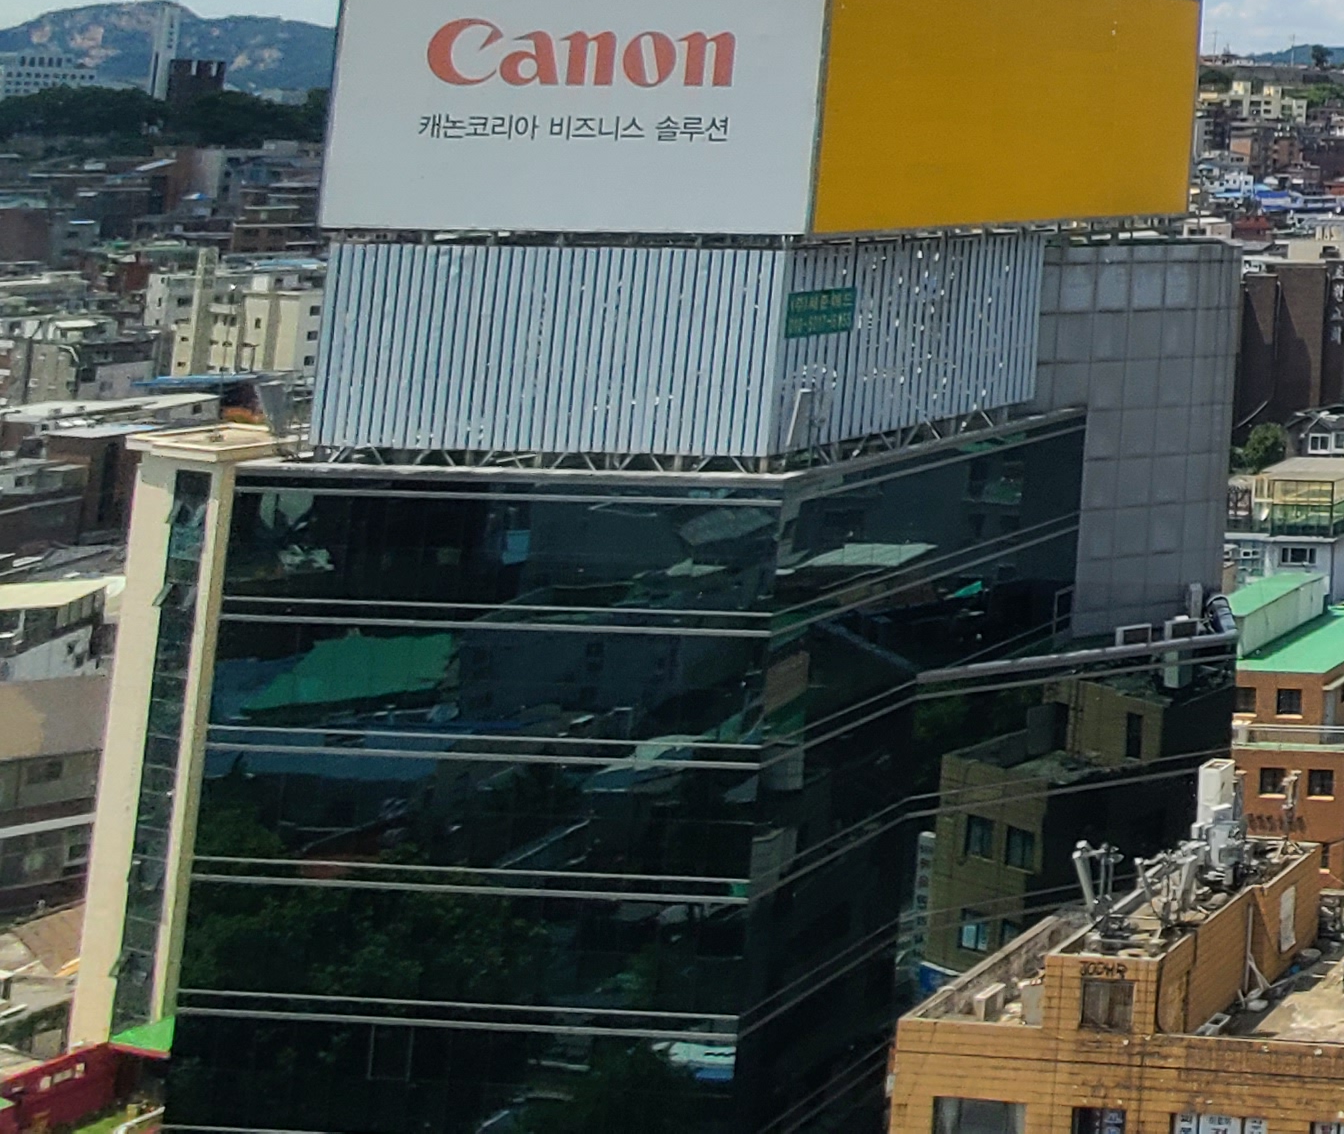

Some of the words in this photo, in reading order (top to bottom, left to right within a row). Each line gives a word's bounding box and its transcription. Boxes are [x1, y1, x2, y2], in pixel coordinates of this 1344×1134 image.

[427, 18, 736, 88] Canon
[418, 114, 540, 140] 캐논코리아
[549, 115, 646, 141] 비즈니스
[655, 115, 730, 142] 솔루션
